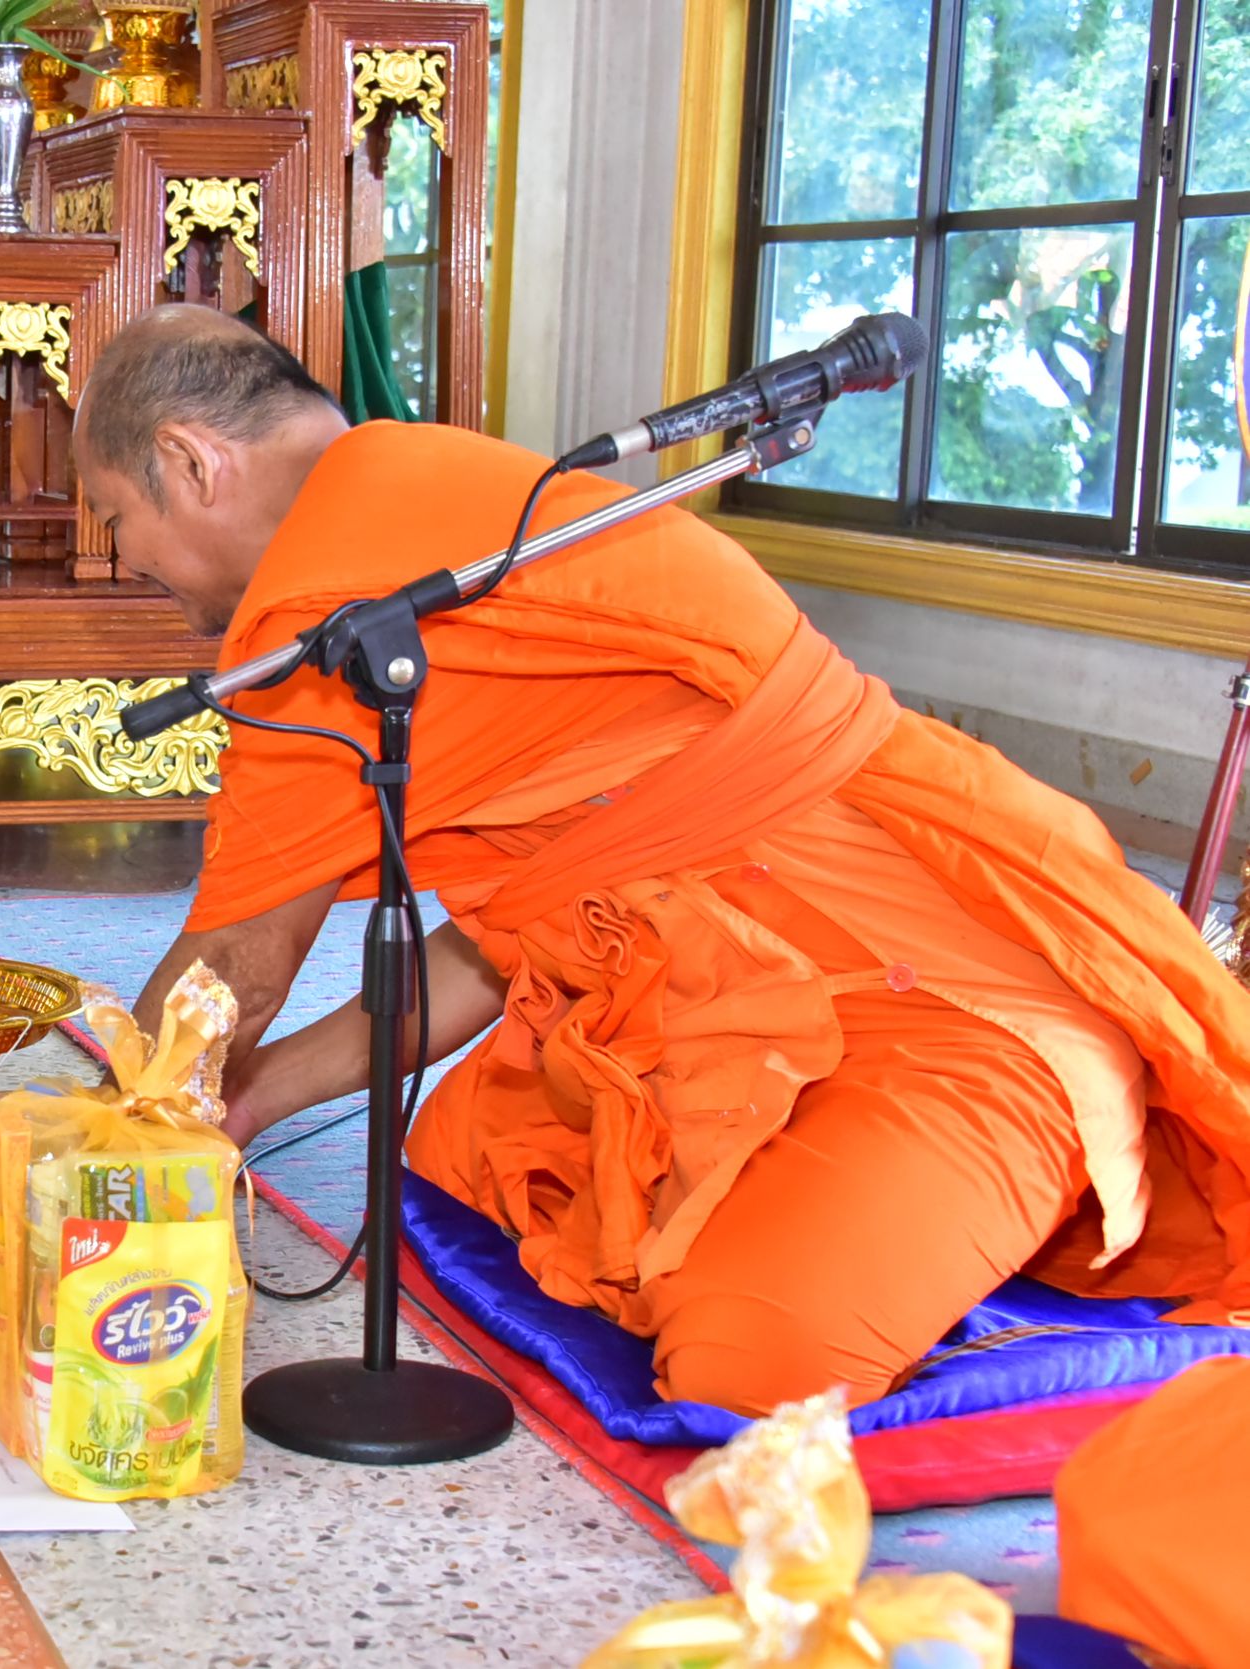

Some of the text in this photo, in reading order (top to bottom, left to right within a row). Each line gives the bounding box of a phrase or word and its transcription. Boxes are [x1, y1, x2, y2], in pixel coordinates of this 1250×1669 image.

[69, 1228, 100, 1265] ใหม่
[117, 1331, 185, 1360] Revive plus
